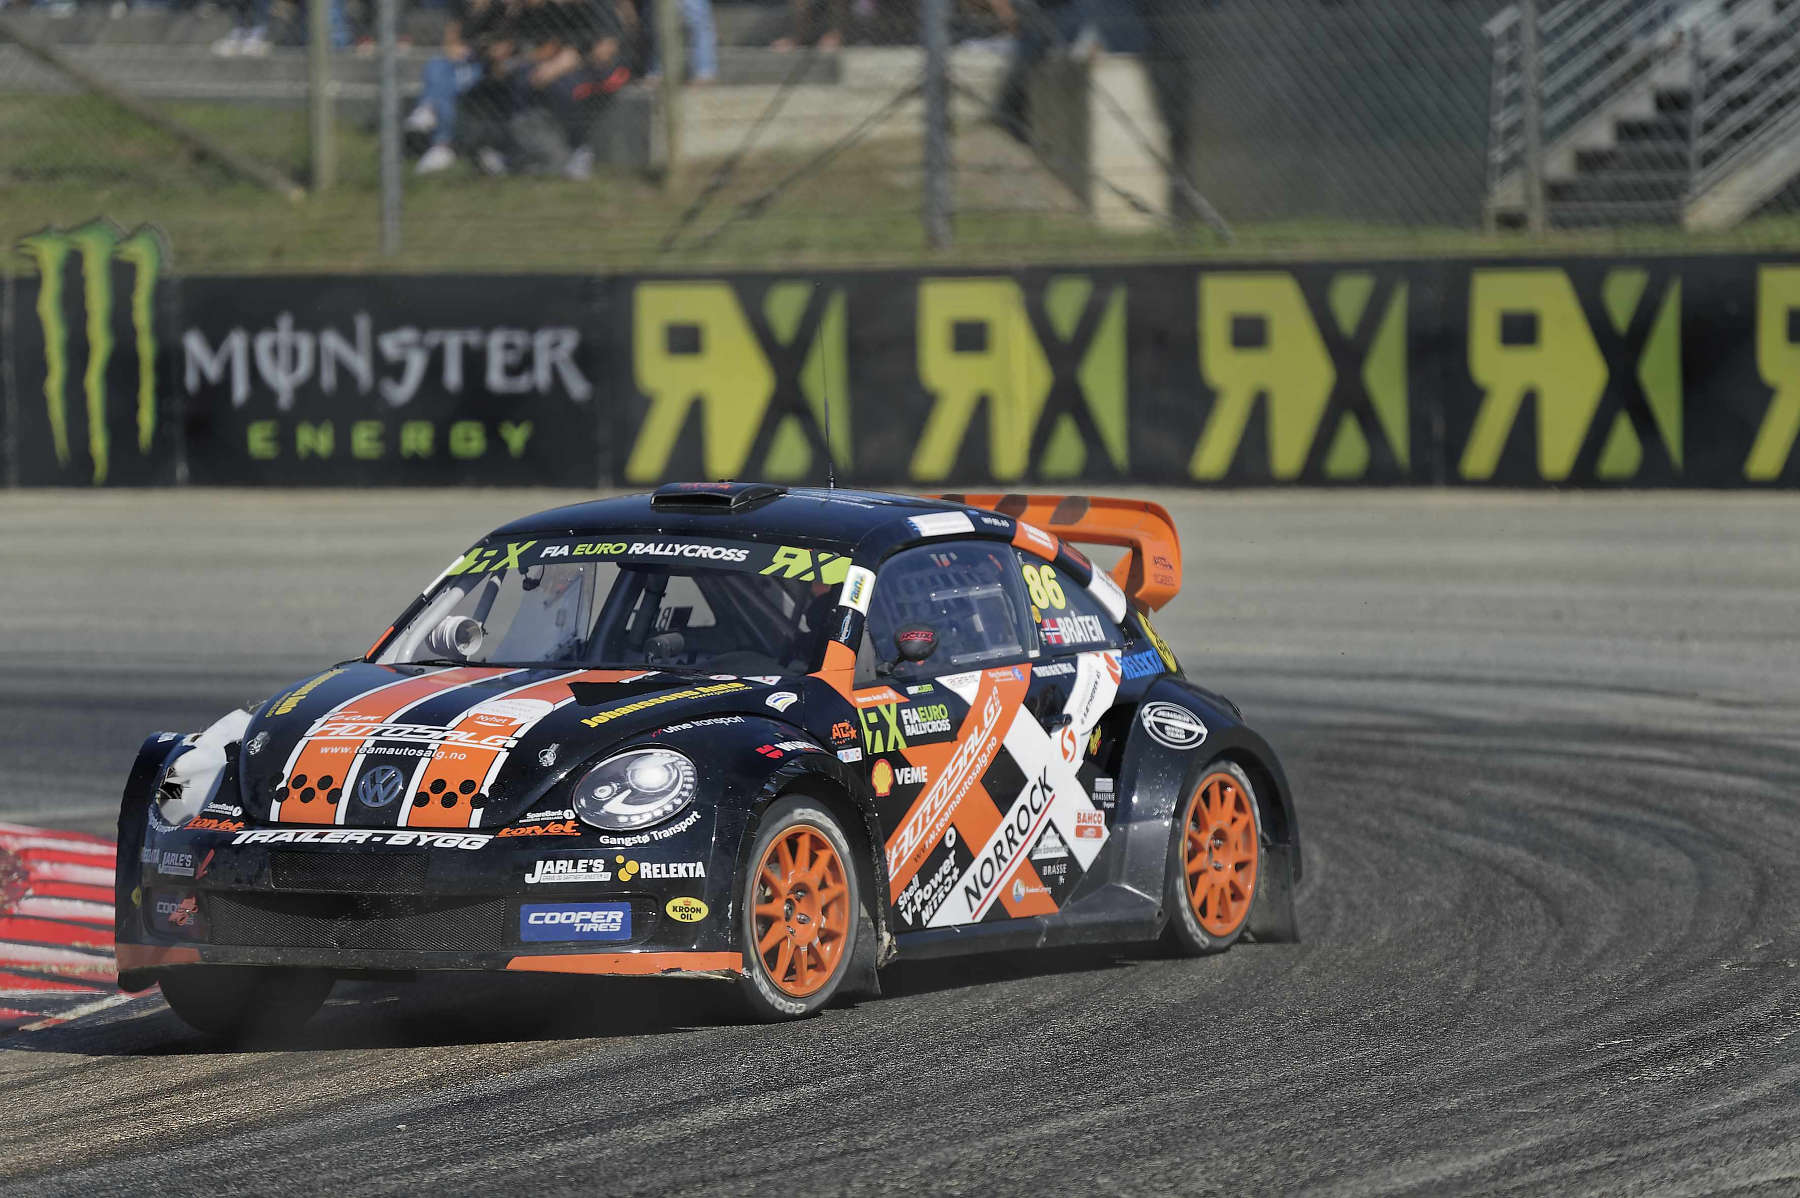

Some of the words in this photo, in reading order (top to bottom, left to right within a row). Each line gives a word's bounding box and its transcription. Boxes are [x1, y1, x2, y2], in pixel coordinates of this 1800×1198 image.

[625, 279, 849, 479] RX
[909, 277, 1128, 478] RX
[1188, 271, 1409, 476] RX
[1460, 268, 1684, 478] RX
[247, 419, 534, 458] ENERGY
[540, 544, 570, 558] FIA
[572, 542, 628, 556] EURO
[627, 543, 750, 562] RALLYCROSS
[1022, 564, 1067, 610] 86
[1059, 611, 1107, 644] BRÅTEN
[904, 719, 952, 737] RALLYCROSS
[319, 745, 468, 760] www.teamautosalg.no
[894, 765, 928, 786] VEME
[526, 810, 564, 820] SpareBank
[1077, 812, 1102, 825] BAHCO
[599, 835, 650, 847] Gangstø
[650, 810, 702, 841] Transport
[964, 765, 1055, 913] NORROCK
[525, 859, 606, 884] JARLE'S
[640, 861, 706, 879] RELEKTA
[901, 850, 958, 927] V-Power
[528, 911, 624, 924] COOPER
[672, 905, 702, 914] KROON
[680, 913, 694, 921] OIL
[573, 923, 622, 932] TIRES
